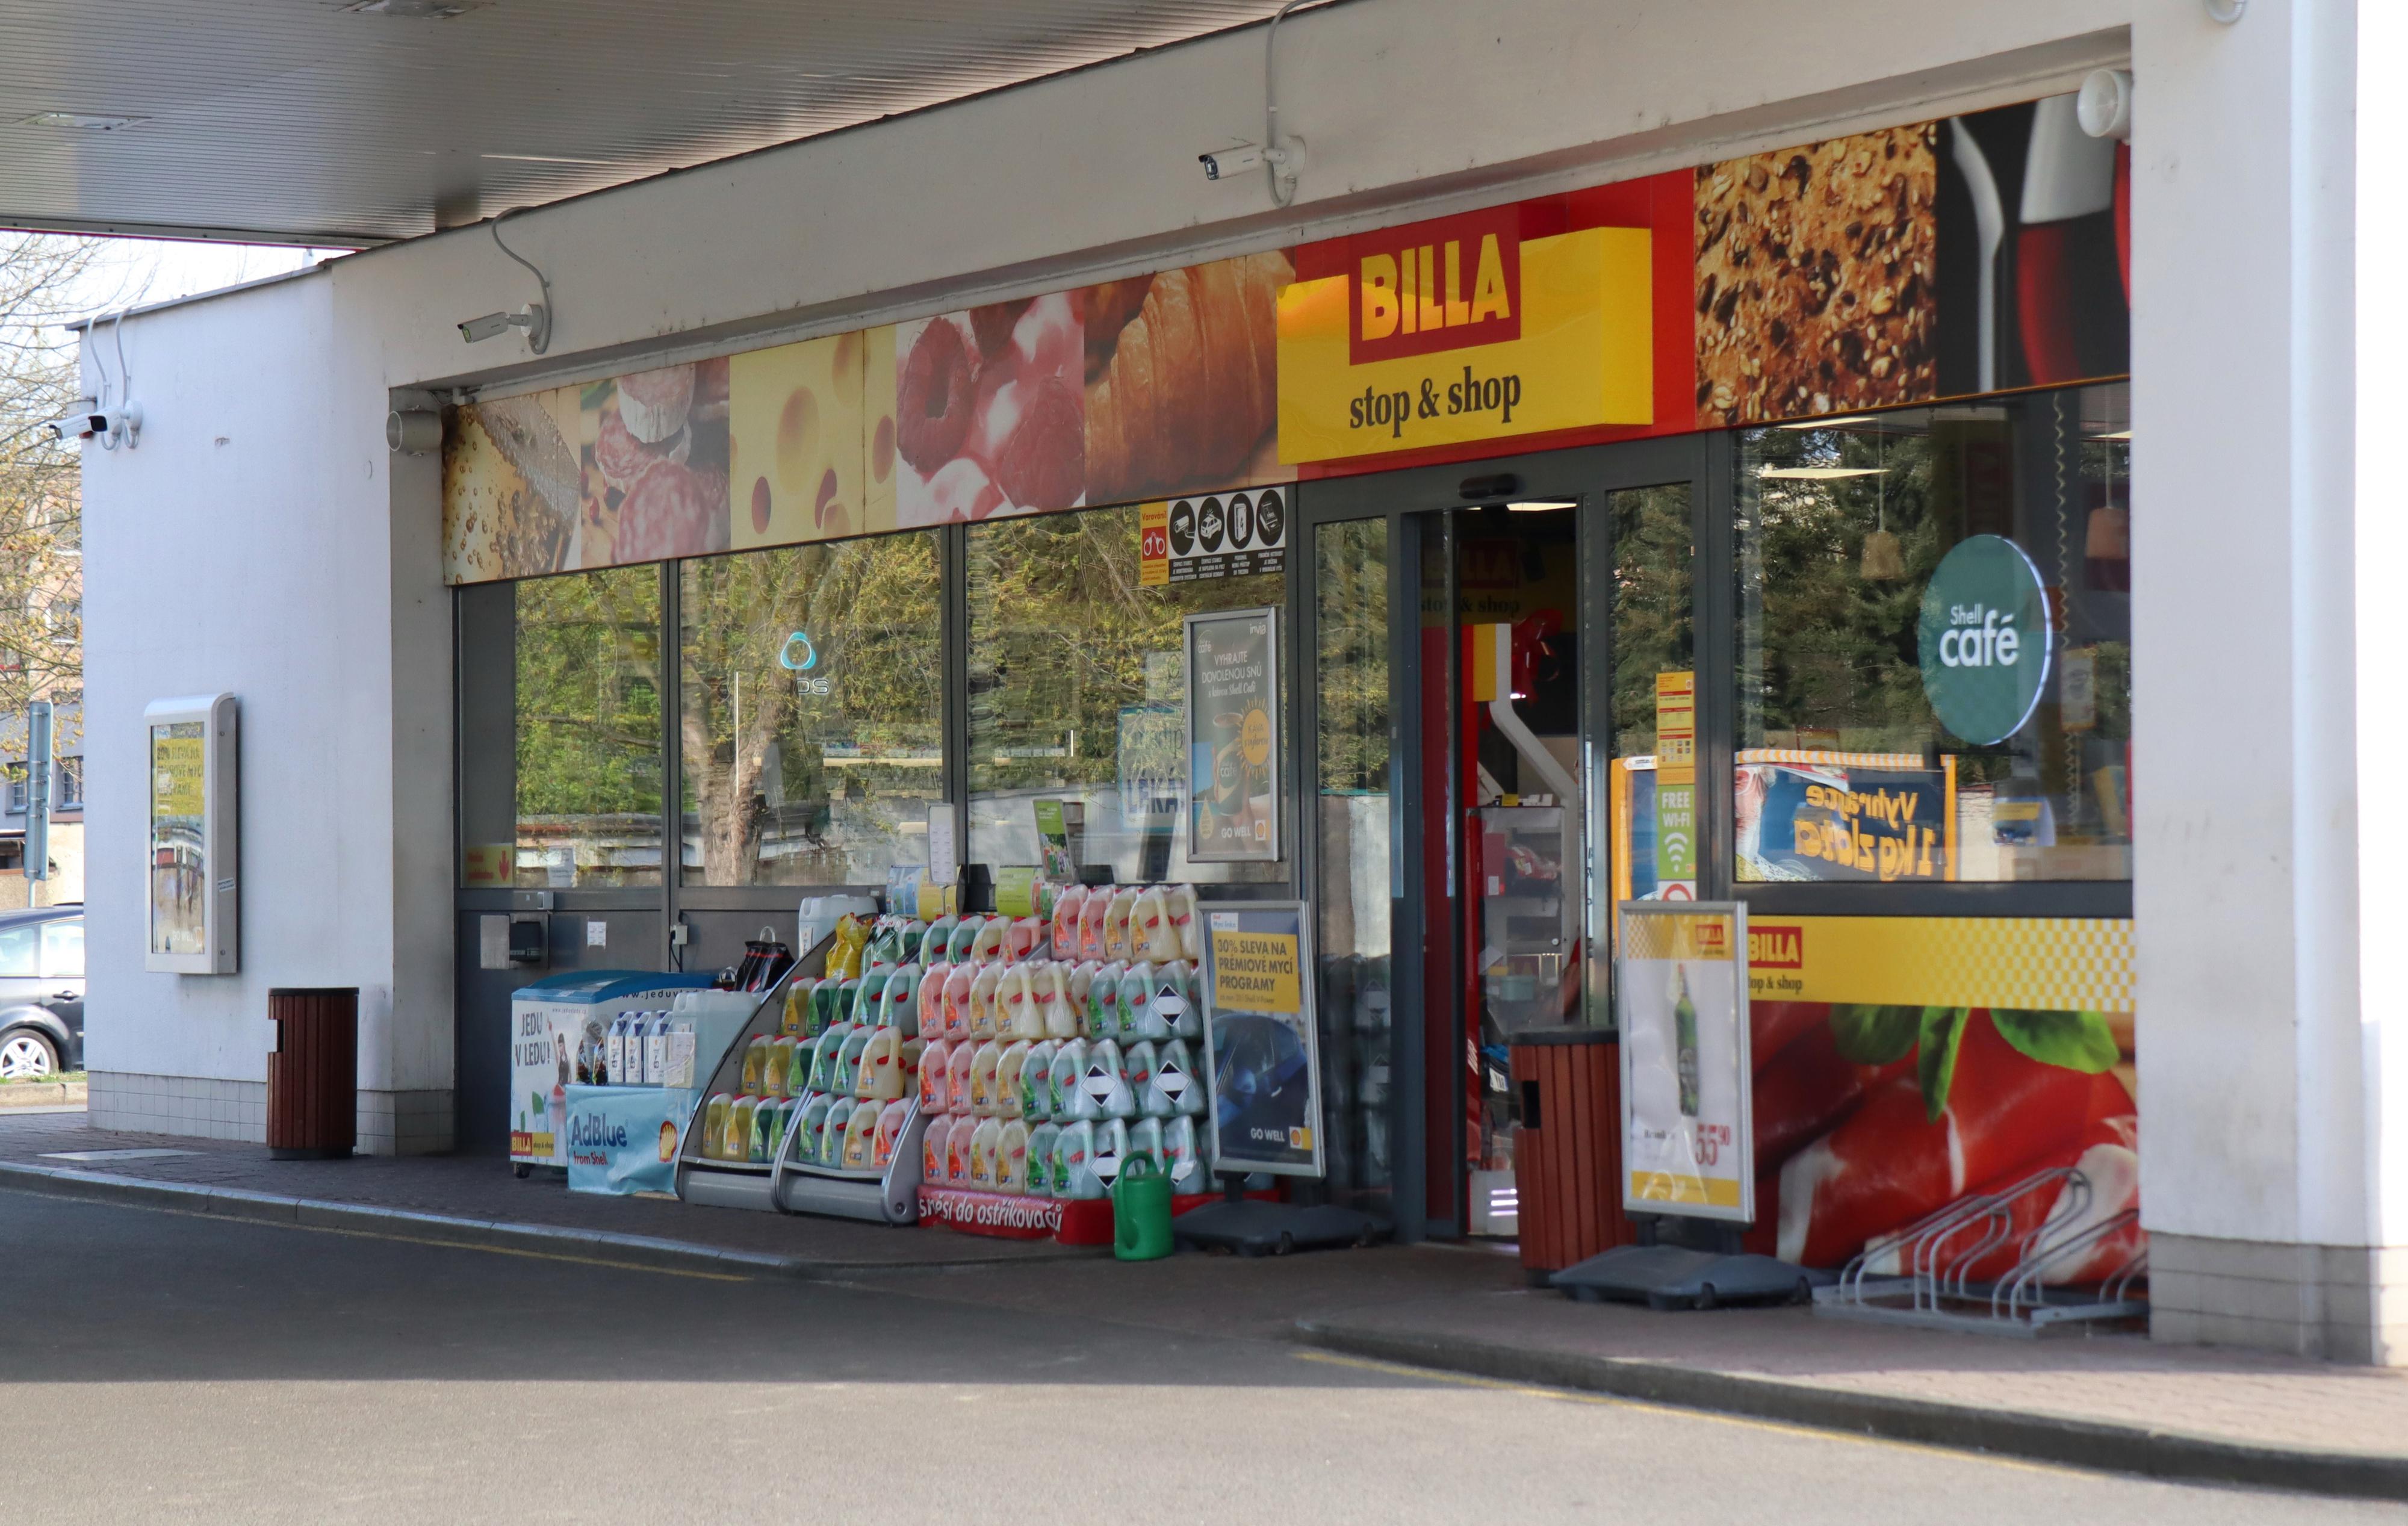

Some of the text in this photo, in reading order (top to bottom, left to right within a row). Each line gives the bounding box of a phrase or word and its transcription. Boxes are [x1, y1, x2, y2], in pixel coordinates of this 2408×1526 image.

[1361, 233, 1510, 341] BILLA
[1350, 365, 1521, 438] stop & shop
[1950, 603, 1984, 625] Shell
[1249, 622, 1267, 635] invia
[1940, 609, 2019, 668] café
[1214, 651, 1248, 666] VYHRAJTE
[1202, 661, 1262, 683] DOVOLENOU SNŮ
[1662, 792, 1690, 808] FREE
[1221, 825, 1251, 838] GO WELL
[1218, 939, 1286, 955] 30% SLEVA NA
[1749, 934, 1799, 963] BILLA
[1219, 954, 1293, 974] PRÉMIOVÉ MYCÍ
[1220, 975, 1275, 991] PROGRAMY
[1749, 975, 1802, 994] top & shop
[521, 1011, 542, 1037] JEDU
[515, 1040, 550, 1067] V LEDU!
[572, 1113, 627, 1147] AdBlue
[1250, 1127, 1285, 1142] GO WELL
[512, 1135, 531, 1153] BILLA
[1695, 1124, 1730, 1166] 55 90
[573, 1151, 608, 1165] from Shell
[956, 1195, 973, 1223] do
